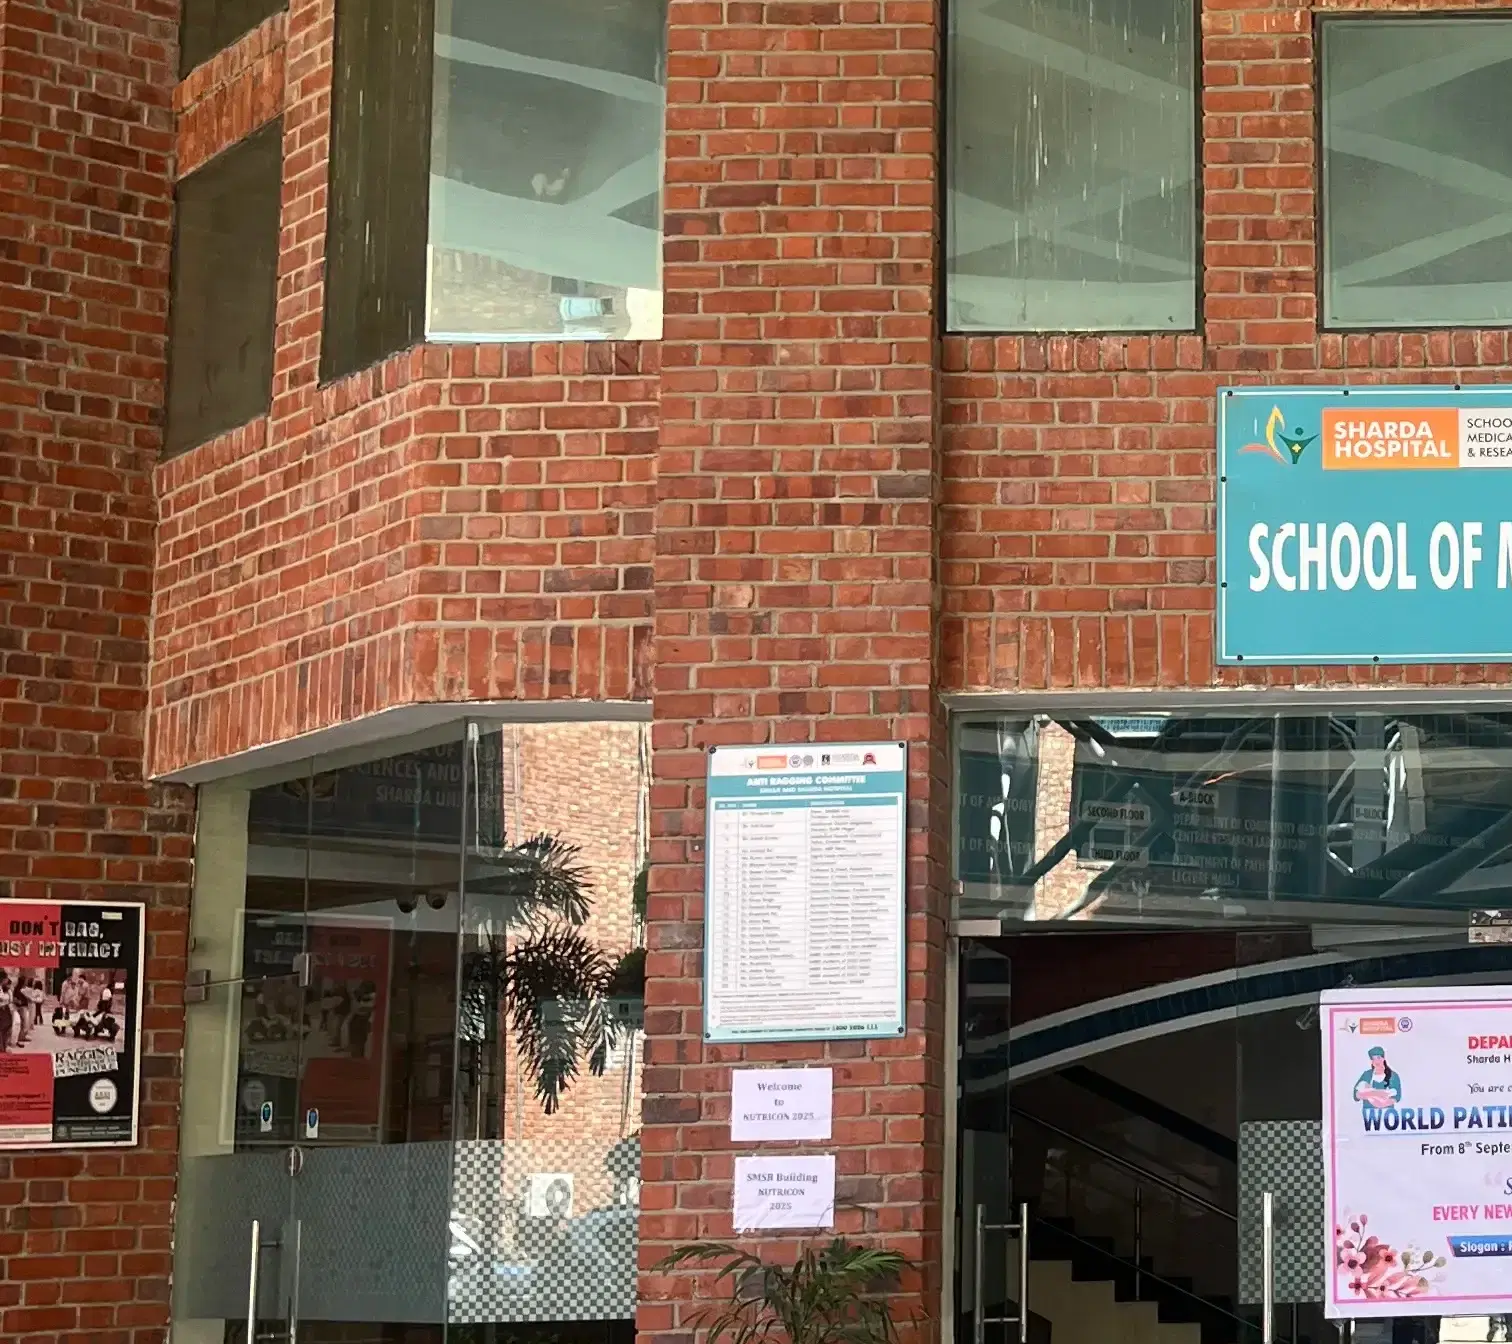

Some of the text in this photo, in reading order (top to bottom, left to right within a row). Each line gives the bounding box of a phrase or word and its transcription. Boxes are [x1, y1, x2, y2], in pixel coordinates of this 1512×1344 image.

[1333, 420, 1433, 440] SHARDA
[1334, 439, 1452, 459] HOSPITAL
[1466, 447, 1476, 457] &
[1248, 521, 1417, 592] SCHOOL
[1429, 520, 1483, 590] OF
[38, 941, 122, 958] INTERACT
[1466, 1054, 1501, 1064] Sharda
[757, 1082, 802, 1091] Welcome
[1467, 1082, 1485, 1095] You
[1488, 1084, 1505, 1092] are
[774, 1098, 784, 1107] to
[743, 1113, 790, 1121] NUTRICON
[1362, 1106, 1445, 1132] WORLD
[1421, 1143, 1455, 1156] From
[776, 1172, 818, 1184] Building
[758, 1188, 805, 1196] NUTRICON
[1432, 1204, 1479, 1221] EVERY
[1460, 1240, 1498, 1254] Slogan
